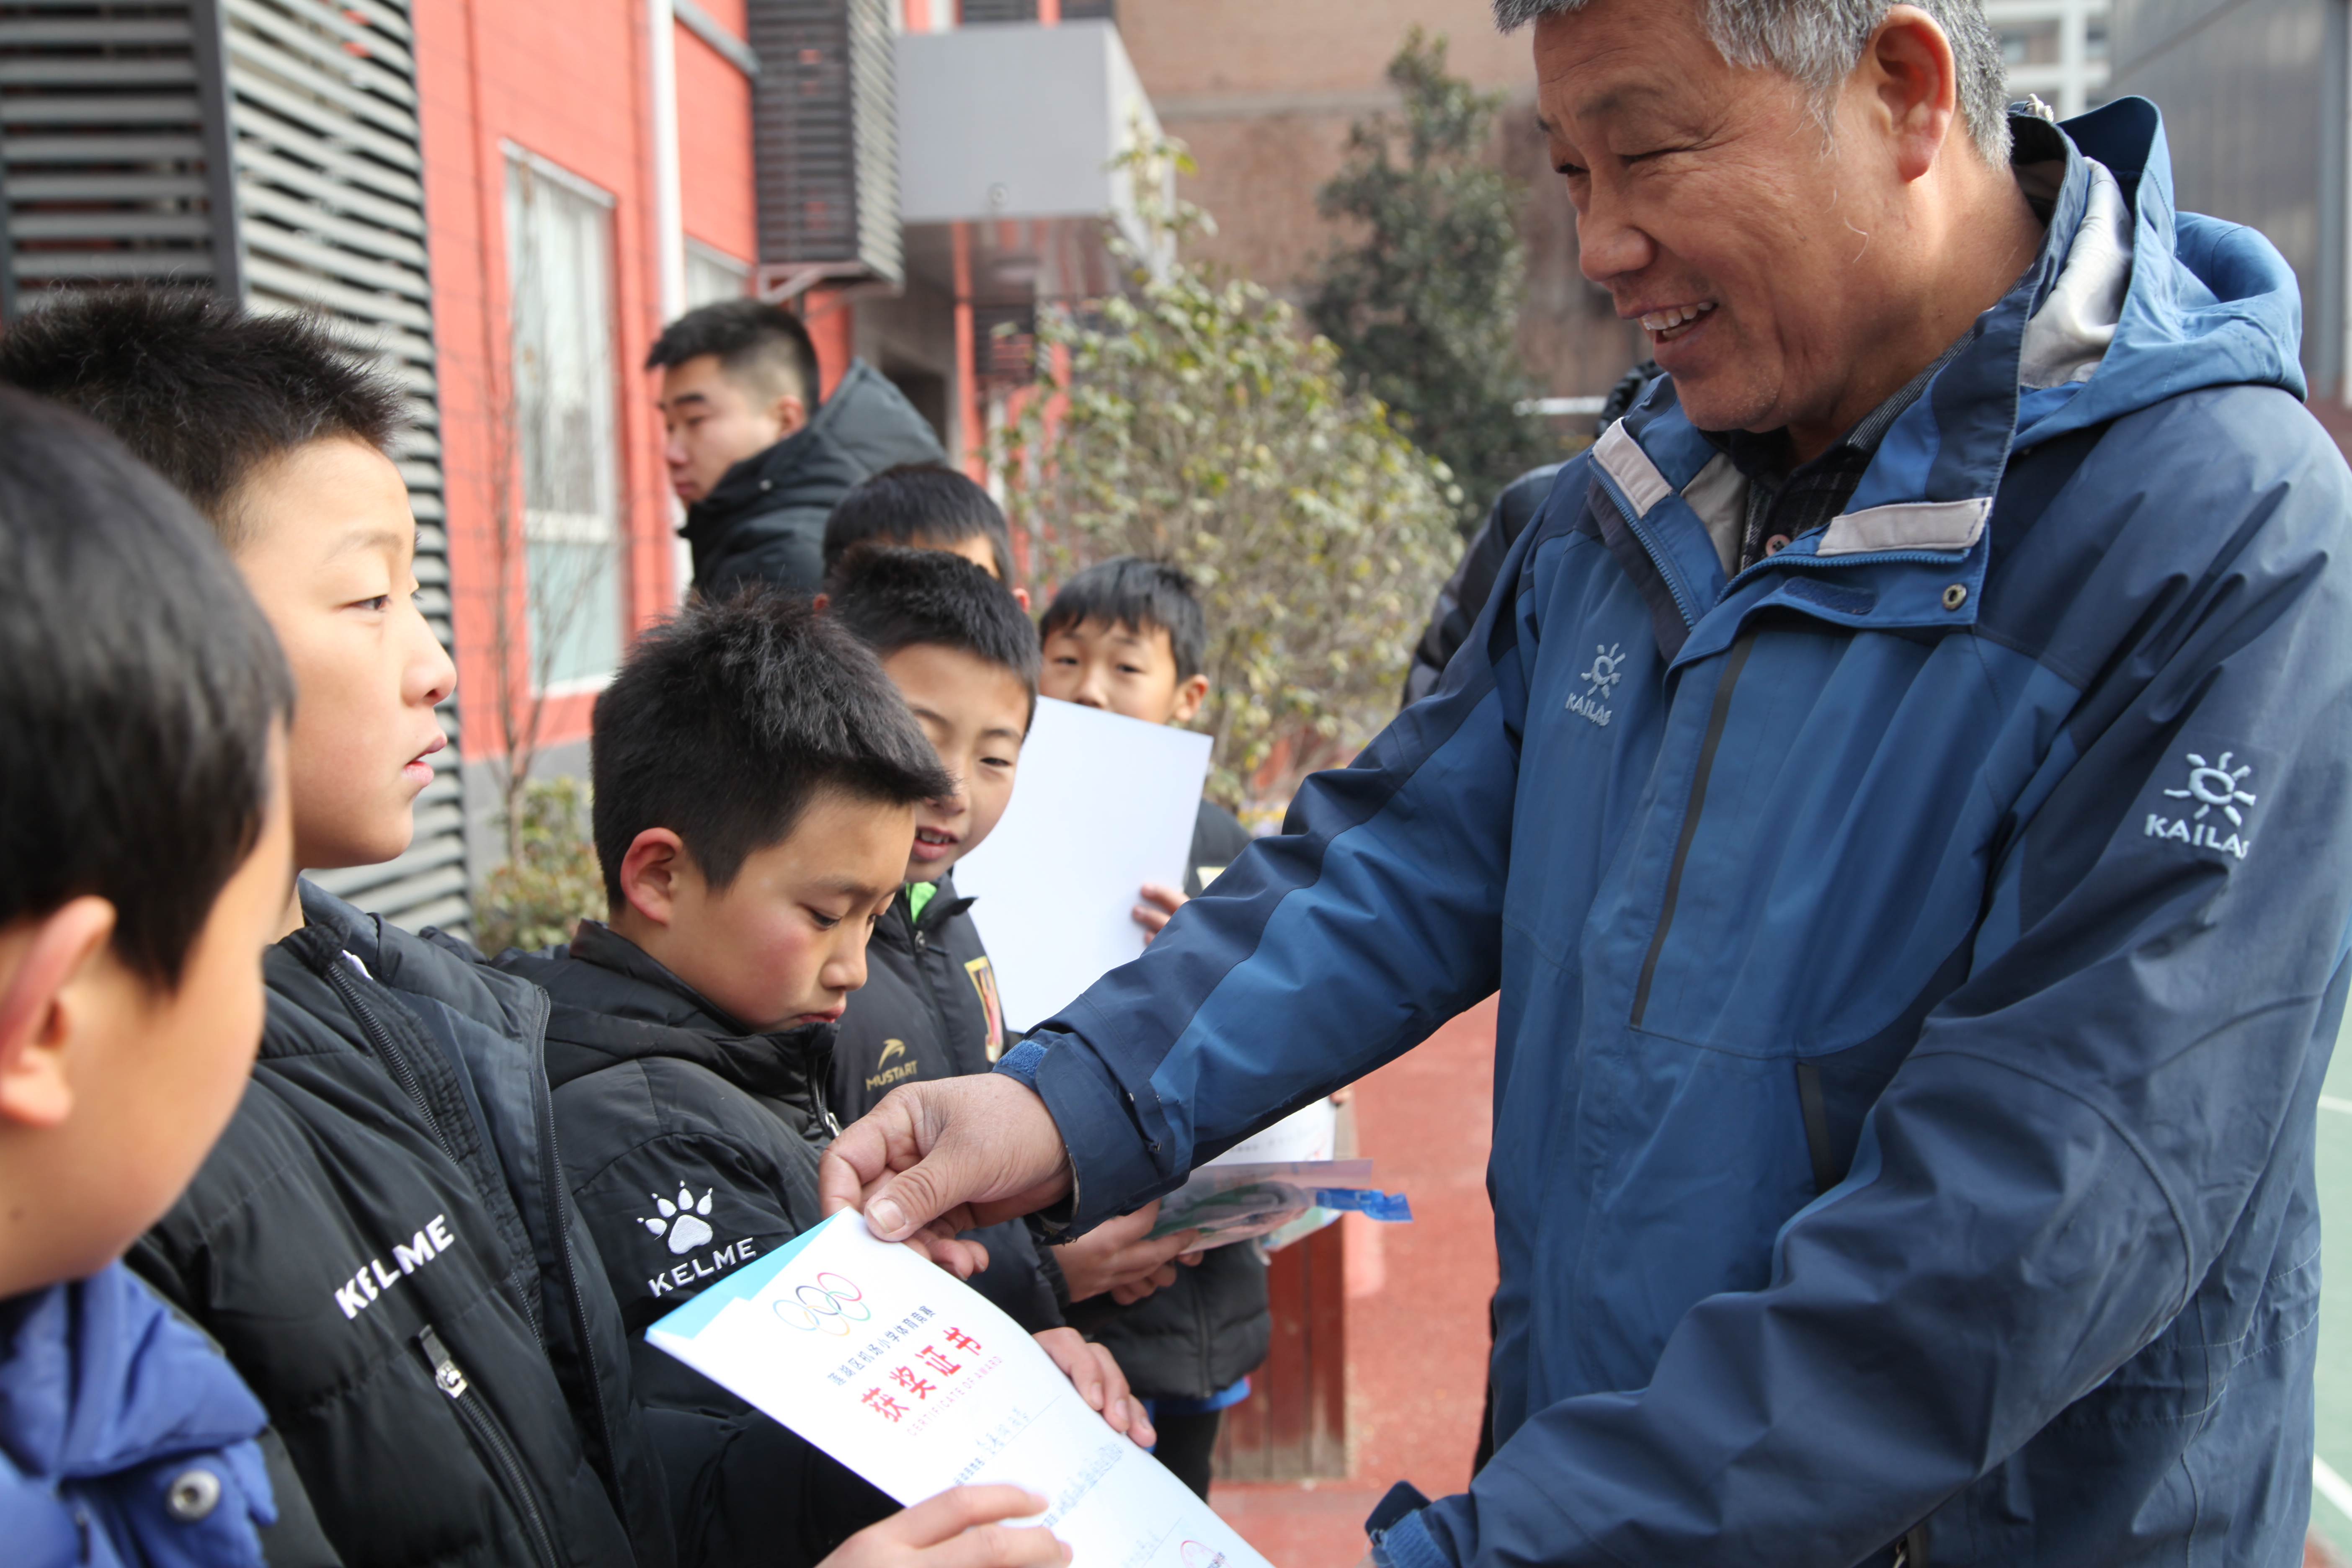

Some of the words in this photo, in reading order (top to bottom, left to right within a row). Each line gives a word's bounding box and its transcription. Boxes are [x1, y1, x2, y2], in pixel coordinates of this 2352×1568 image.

[866, 1060, 918, 1091] MUSTART
[335, 1214, 455, 1320] KELME
[647, 1237, 757, 1298] KELME
[861, 1327, 982, 1422] 获奖证书
[907, 1387, 965, 1436] CERTIFICATE
[962, 1377, 976, 1389] OF
[974, 1356, 1003, 1379] AWARD
